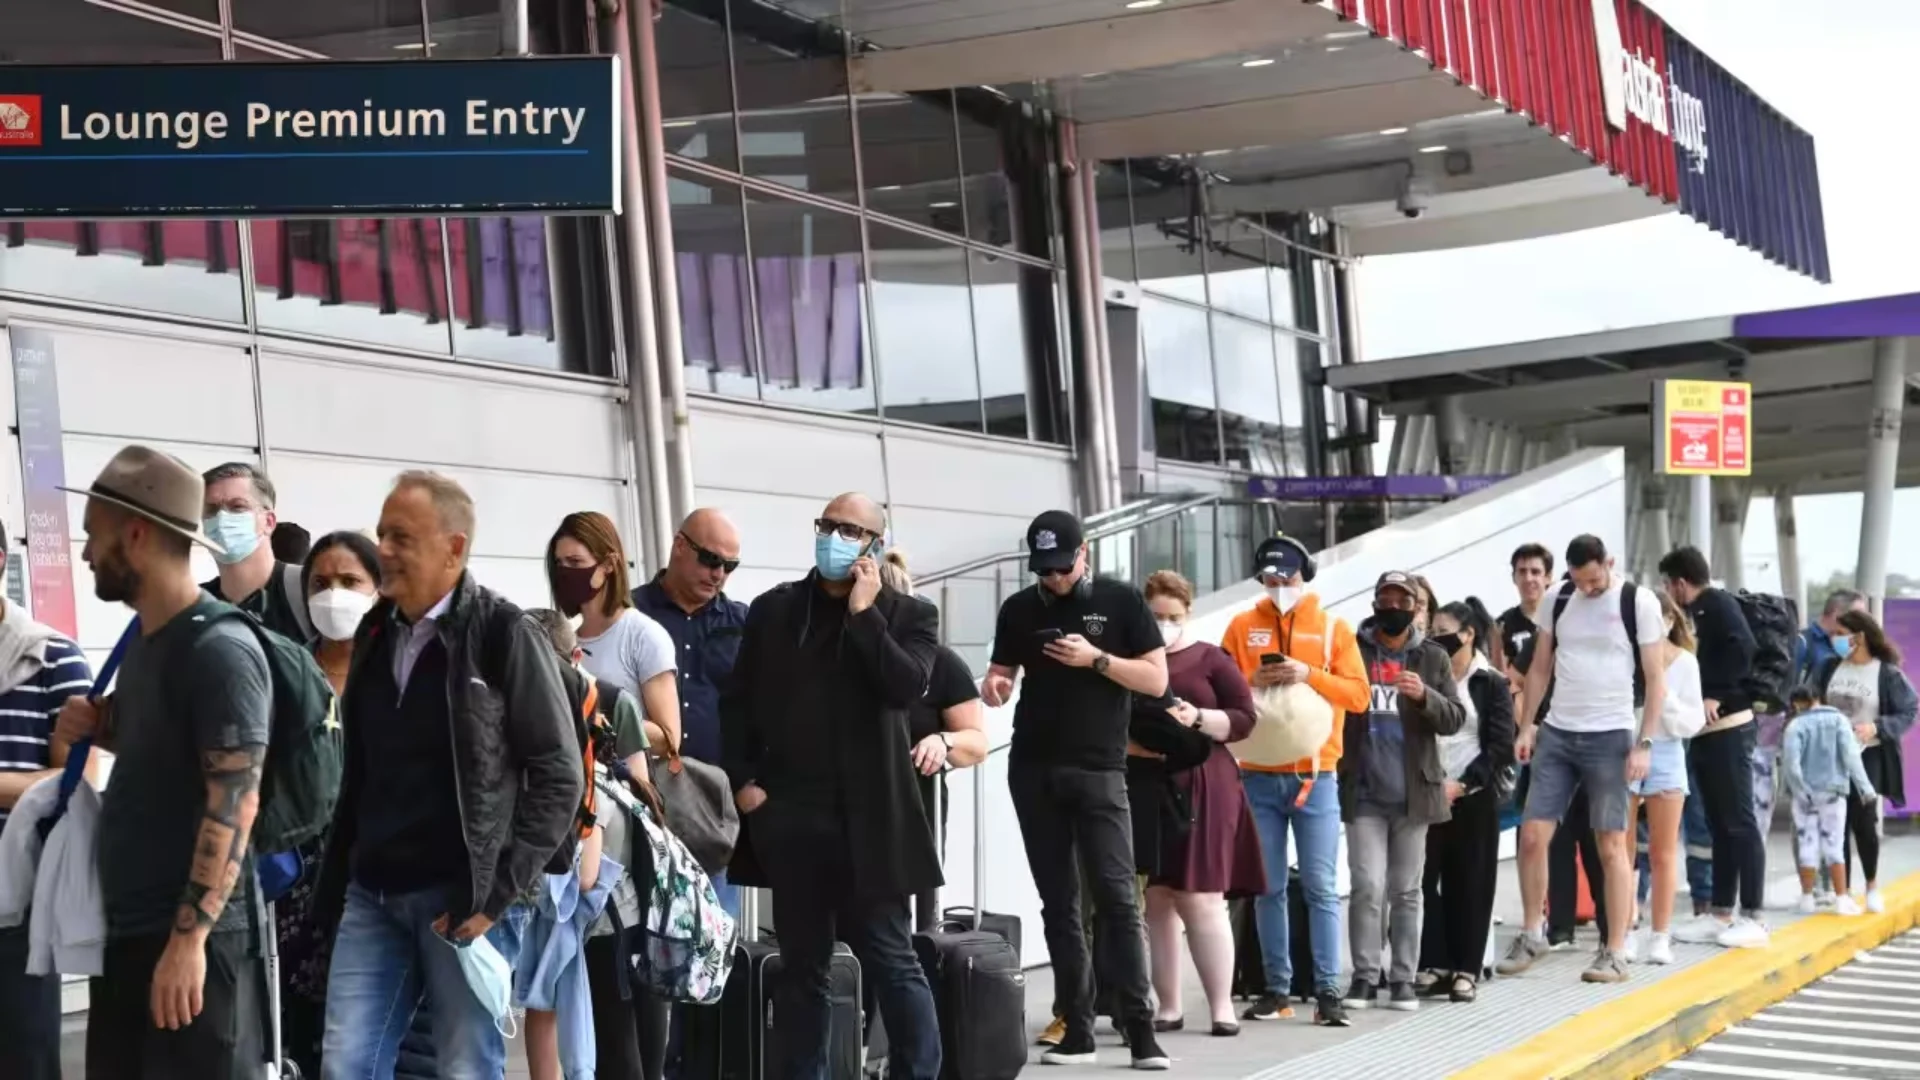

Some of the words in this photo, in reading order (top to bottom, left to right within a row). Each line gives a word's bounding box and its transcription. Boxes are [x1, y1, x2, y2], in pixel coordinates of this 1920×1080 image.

[0, 131, 34, 139] ustralia
[60, 105, 228, 148] Lounge
[247, 100, 446, 138] Premium
[466, 99, 586, 145] Entry
